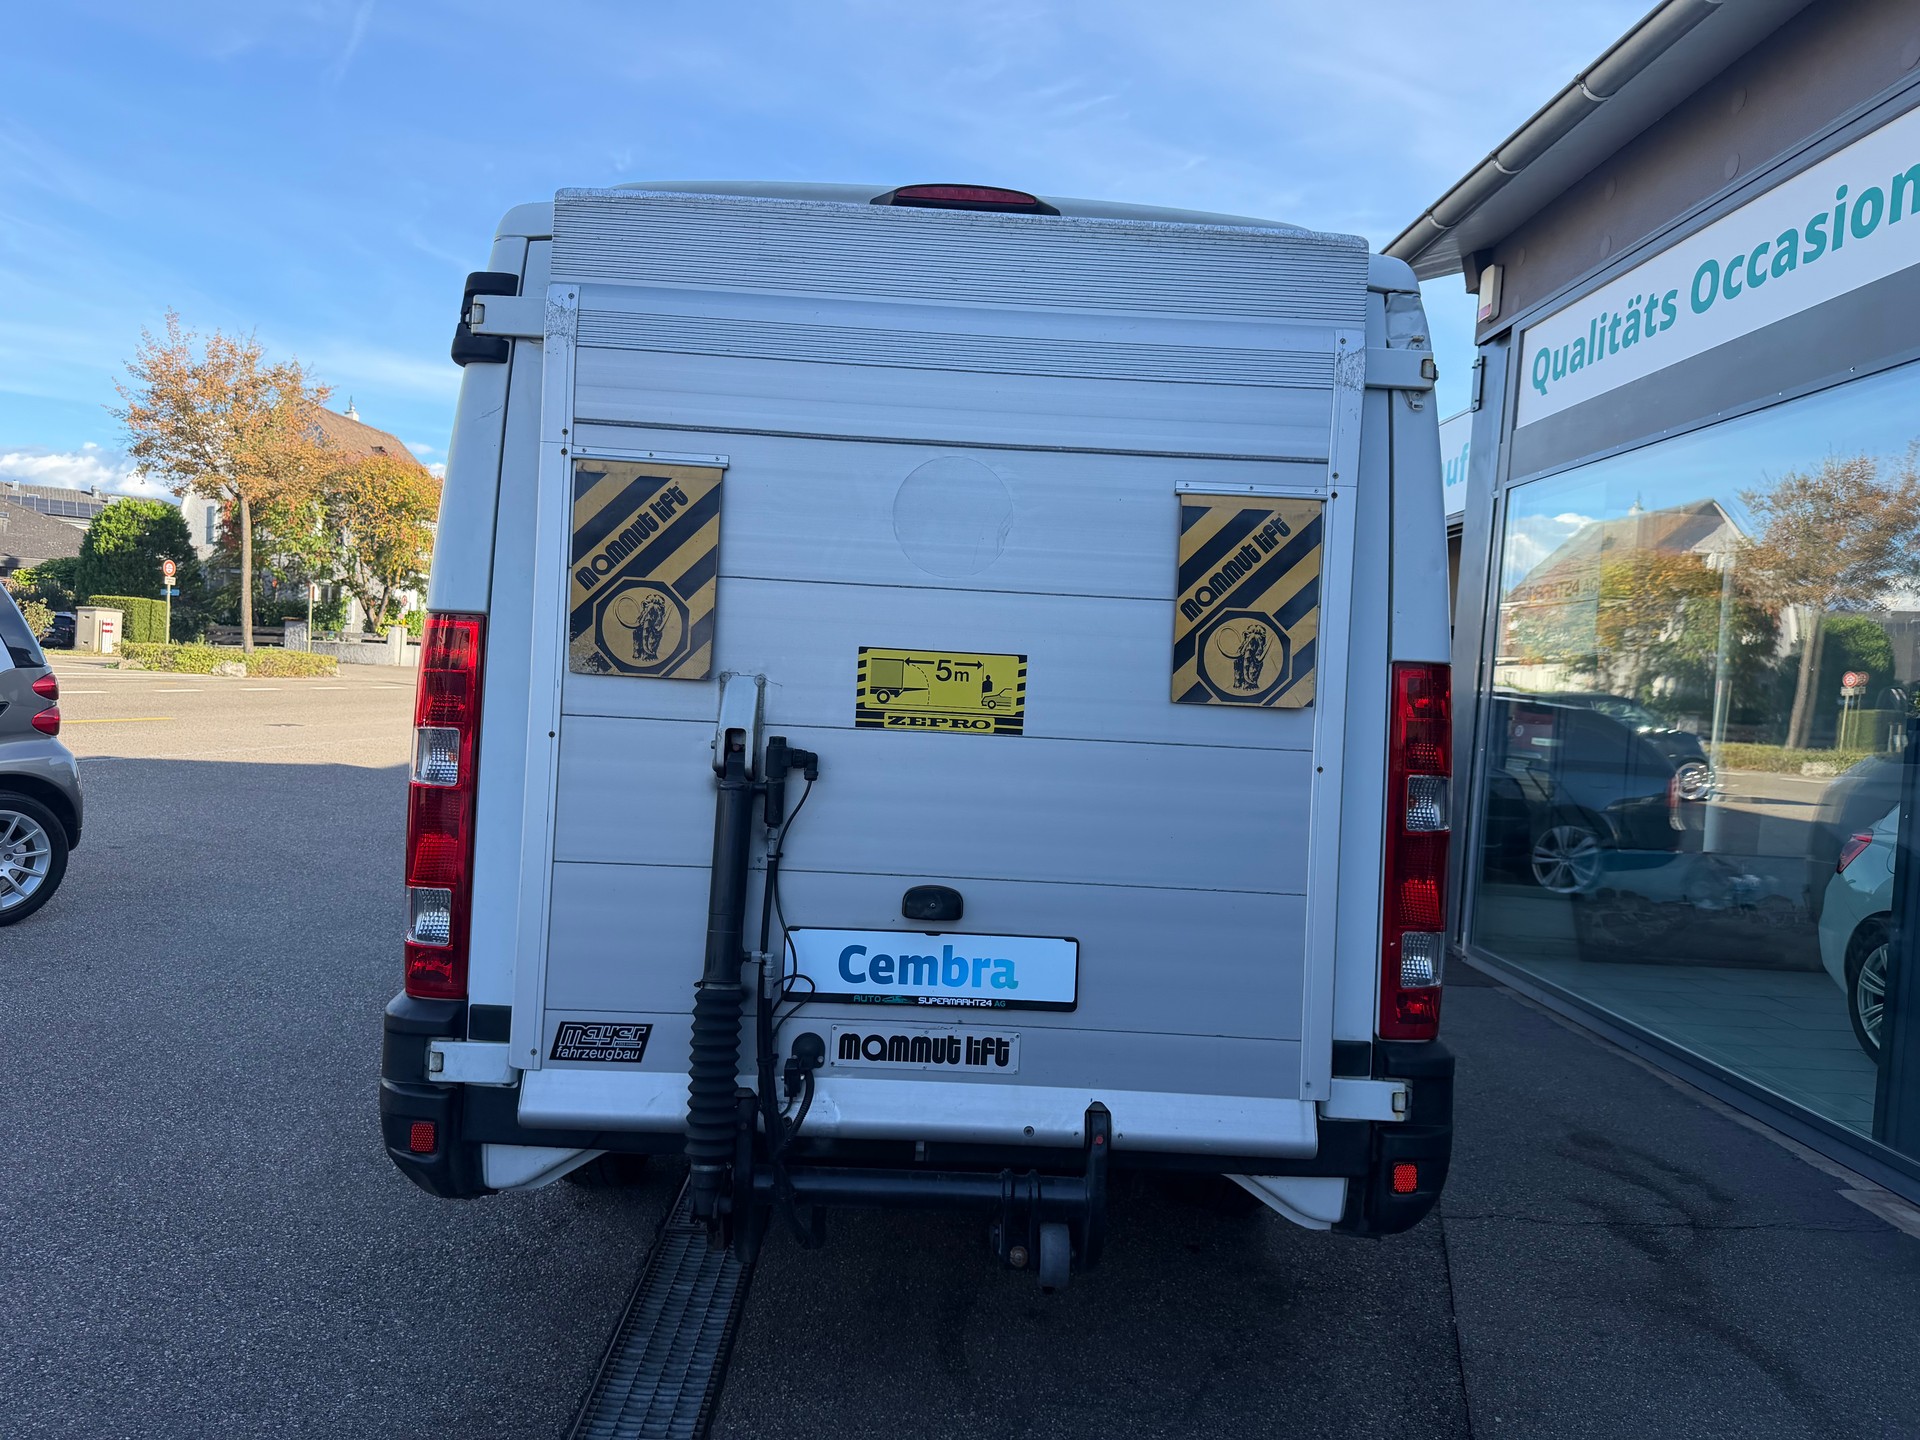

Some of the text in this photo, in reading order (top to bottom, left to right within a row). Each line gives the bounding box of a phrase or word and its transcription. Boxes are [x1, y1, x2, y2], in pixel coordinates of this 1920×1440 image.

[1532, 287, 1680, 397] Qualitäts
[575, 485, 689, 591] mammut lift
[1180, 516, 1291, 623] mammut lift
[887, 715, 992, 730] ZEPRO
[838, 944, 1020, 990] Cembra
[853, 994, 882, 1004] AUTO
[994, 999, 1006, 1008] AG
[556, 1046, 639, 1061] fahrzeugbau
[838, 1033, 1010, 1068] mammut lift
